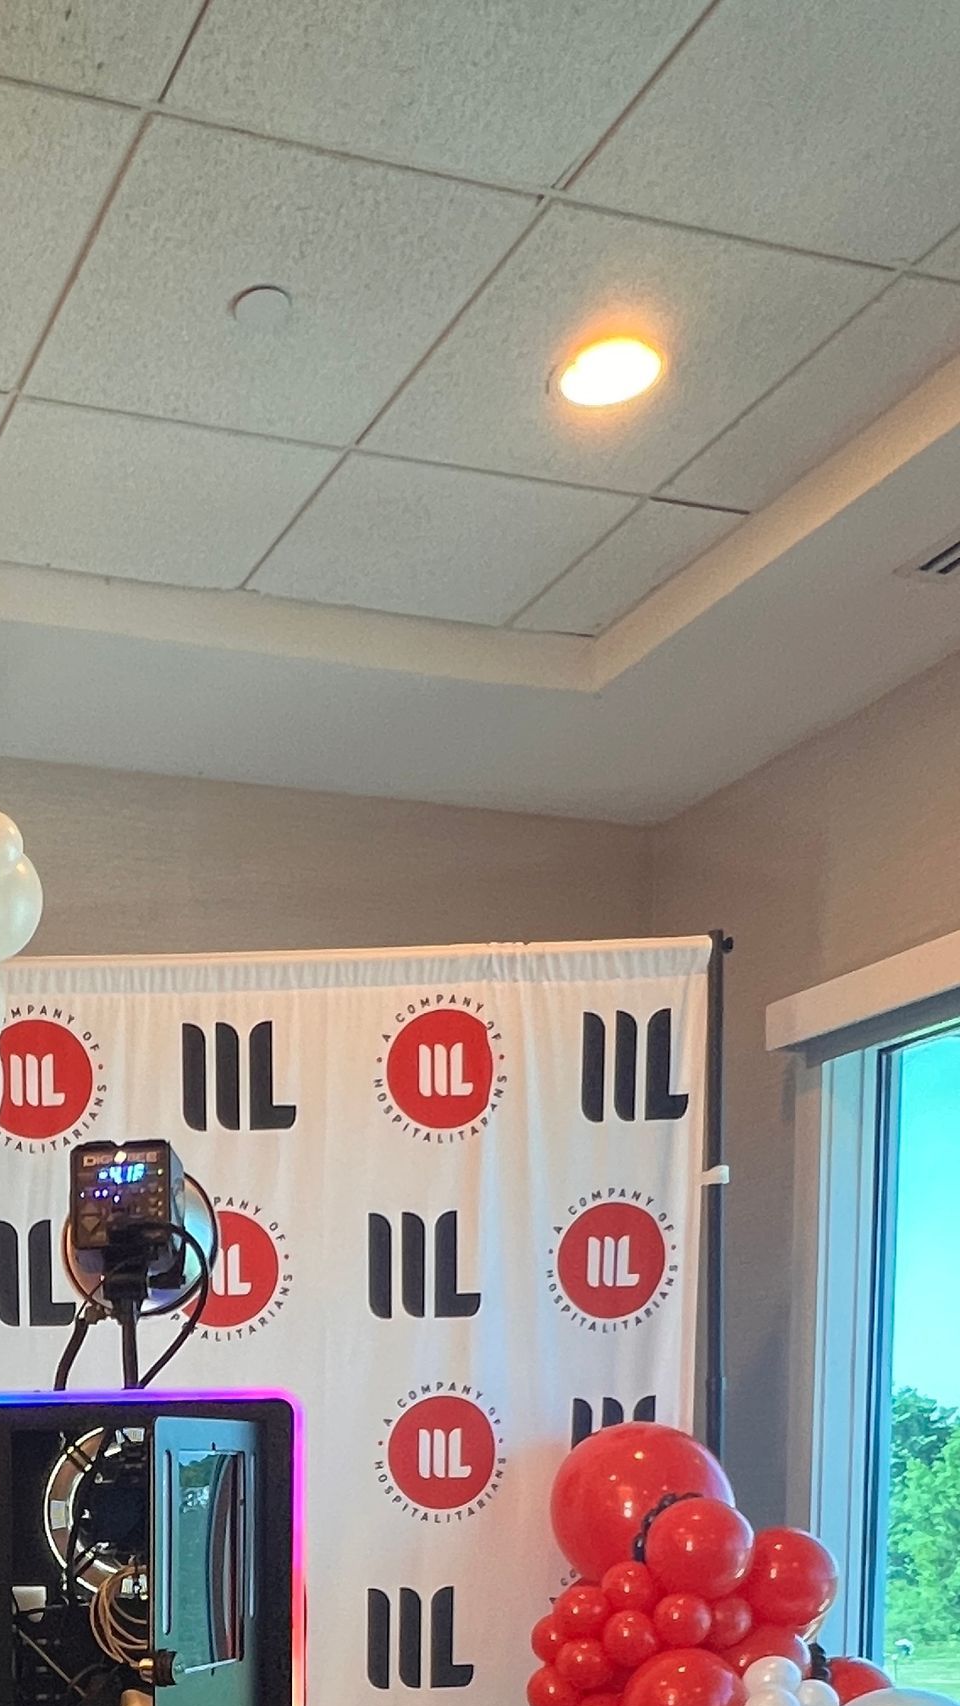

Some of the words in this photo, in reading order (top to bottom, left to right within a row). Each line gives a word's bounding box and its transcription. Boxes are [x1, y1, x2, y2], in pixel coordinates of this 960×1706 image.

[4, 1005, 75, 1024] MPANY
[83, 1031, 100, 1052] OF
[382, 1033, 391, 1042] A
[395, 994, 484, 1023] COMPANY
[568, 1187, 654, 1216] COMPANY
[213, 1196, 262, 1216] PANY
[269, 1221, 286, 1242] OF
[553, 1225, 563, 1235] A
[658, 1212, 674, 1232] OF
[546, 1264, 678, 1333] HOSPITALITARIANS
[397, 1382, 483, 1409] COMPANY
[383, 1418, 393, 1427] A
[488, 1407, 501, 1425] OF
[374, 1458, 506, 1523] HOSPITALITARIANS
